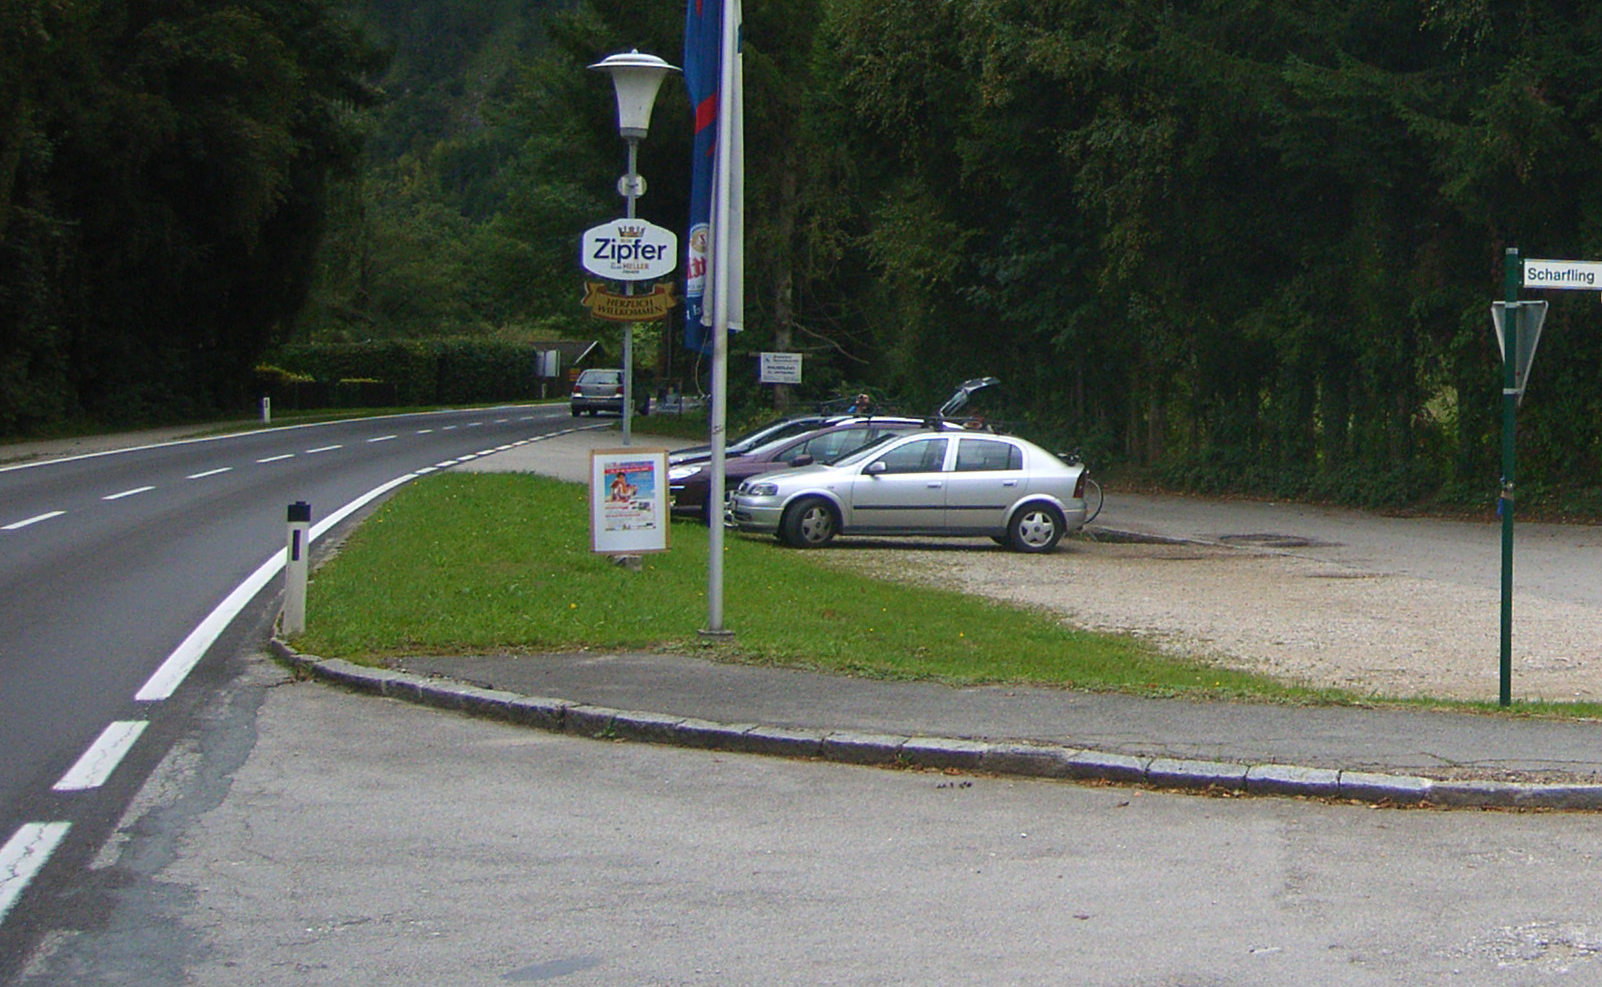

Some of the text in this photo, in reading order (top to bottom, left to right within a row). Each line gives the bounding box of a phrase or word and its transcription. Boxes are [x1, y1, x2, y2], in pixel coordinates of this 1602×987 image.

[593, 237, 668, 264] Zipfer
[1527, 267, 1595, 285] Scharfling
[597, 304, 663, 316] WILLKOMMEN
[607, 298, 653, 309] HERZLICH
